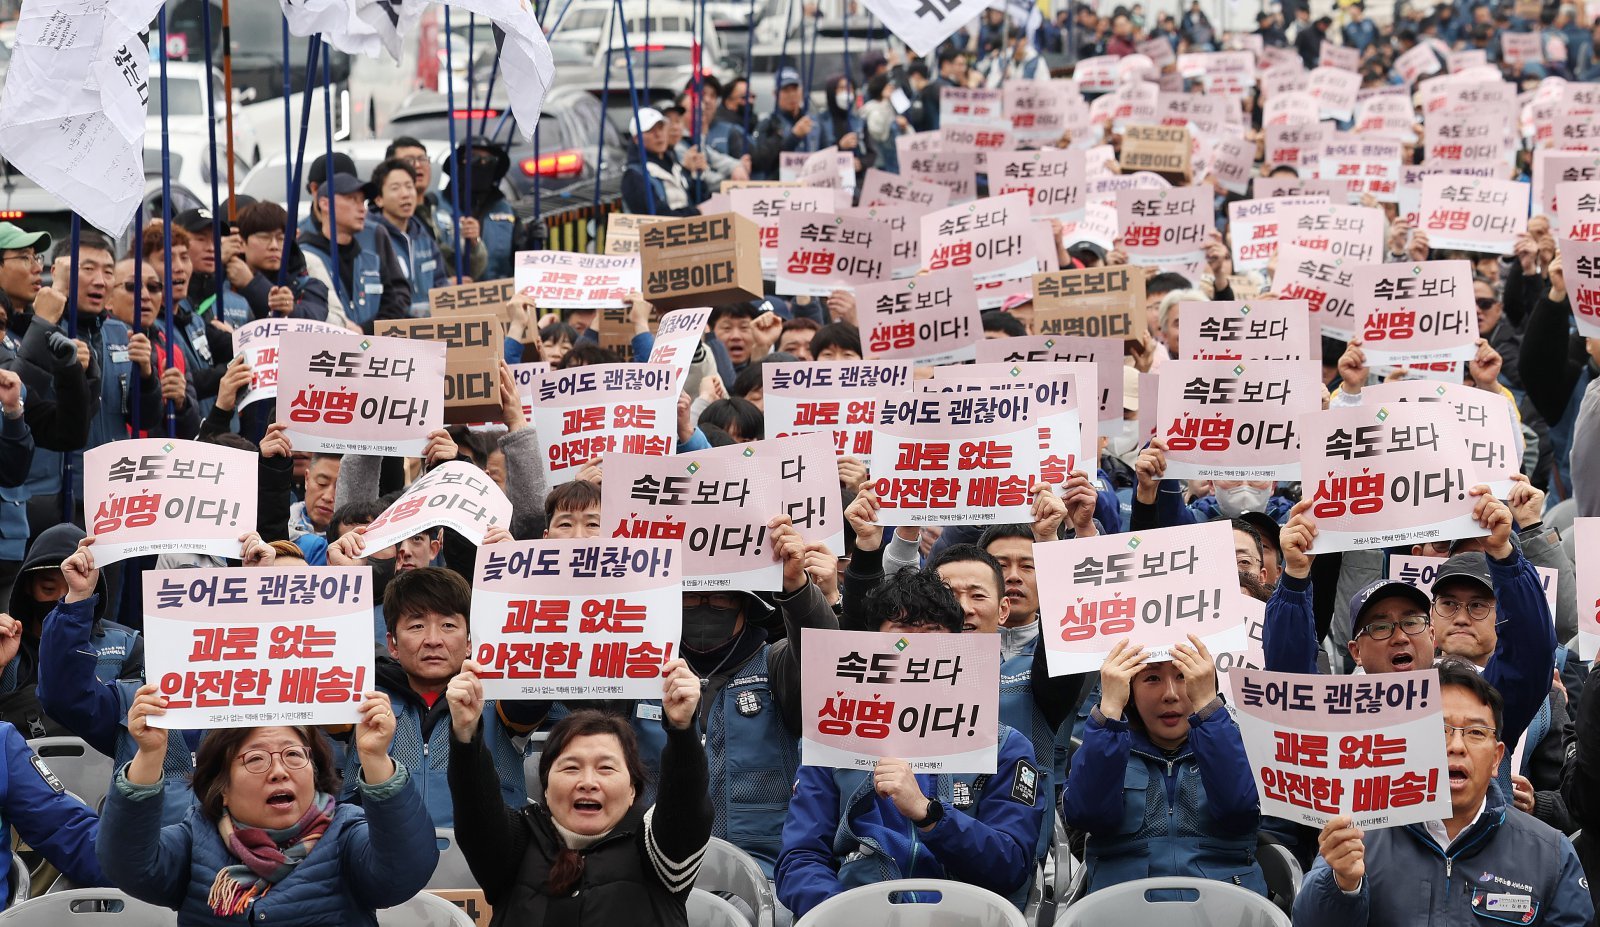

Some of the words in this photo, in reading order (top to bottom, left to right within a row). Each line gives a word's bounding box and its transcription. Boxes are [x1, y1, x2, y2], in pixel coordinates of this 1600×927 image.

[1005, 162, 1068, 178] 속도보다
[1131, 198, 1196, 217] 속도보다
[1440, 186, 1508, 206] 속도보다
[644, 217, 731, 249] 속도보다
[800, 223, 872, 249] 속도보다
[938, 208, 1009, 236] 속도보다
[1124, 224, 1205, 247] 생명이다!
[1297, 214, 1364, 234] 속도보다
[1428, 208, 1518, 234] 생명이다!
[523, 254, 573, 266] 늦어도
[578, 257, 635, 268] 괜찮아!
[787, 250, 882, 280] 생명이다!
[930, 235, 1022, 270] 생명이다!
[539, 272, 578, 286] 과로
[584, 274, 620, 286] 없는
[647, 260, 735, 294] 생명이다
[1038, 270, 1130, 298] 속도보다
[1374, 276, 1456, 301] 속도보다
[876, 287, 952, 315] 속도보다
[869, 316, 969, 353] 생명이다!
[1040, 313, 1132, 338] 생명이다
[1200, 317, 1288, 342] 속도보다
[1364, 310, 1470, 341] 생명이다!
[308, 350, 415, 382] 속도보다
[772, 367, 832, 390] 늦어도
[838, 366, 907, 388] 괜찮아!
[539, 373, 596, 402] 늦어도
[602, 370, 670, 392] 괜찮아!
[1183, 377, 1291, 406] 속도보다
[289, 386, 429, 426] 생명이다!
[561, 407, 606, 436] 과로
[613, 405, 656, 429] 없는
[793, 401, 840, 426] 과로
[880, 399, 941, 425] 늦어도
[948, 397, 1029, 424] 괜찮아!
[895, 443, 950, 472] 과로
[958, 440, 1014, 471] 없는
[1326, 422, 1440, 460] 속도보다
[108, 456, 225, 484] 속도보다
[631, 474, 750, 507] 속도보다
[875, 478, 962, 510] 안전한
[966, 476, 1035, 508] 배송!
[1313, 468, 1466, 518] 생명이다!
[93, 493, 241, 535] 생명이다!
[483, 548, 560, 582] 늦어도
[568, 546, 672, 578] 괜찮아!
[1073, 546, 1198, 586] 속도보다
[156, 576, 248, 610] 늦어도
[257, 574, 362, 606] 괜찮아!
[502, 599, 570, 634] 과로
[578, 598, 647, 634] 없는
[1060, 588, 1221, 642] 생명이다!
[188, 627, 259, 662] 과로
[268, 624, 337, 660] 없는
[476, 642, 582, 680] 안전한
[590, 641, 674, 679] 배송!
[836, 652, 963, 686] 속도보다
[160, 667, 272, 710] 안전한
[278, 665, 366, 703] 배송!
[521, 686, 540, 694] 과로사
[542, 686, 554, 694] 없는
[556, 686, 568, 694] 택배
[570, 686, 590, 694] 만들기
[592, 686, 624, 694] 시민대행진
[1241, 677, 1316, 712] 늦어도
[1324, 679, 1429, 715] 괜찮아!
[209, 714, 229, 723] 과로사
[230, 714, 244, 722] 없는
[245, 713, 258, 721] 택배
[260, 712, 280, 720] 만들기
[281, 712, 314, 720] 시민대행진
[818, 698, 980, 740] 생명이다!
[854, 758, 871, 766] 과로사
[914, 762, 943, 770] 시민대행진
[1273, 730, 1328, 769] 과로
[1338, 734, 1407, 770] 없는
[1260, 766, 1344, 816] 안전한
[1352, 768, 1439, 813] 배송!
[1356, 816, 1389, 828] 시민대행진
